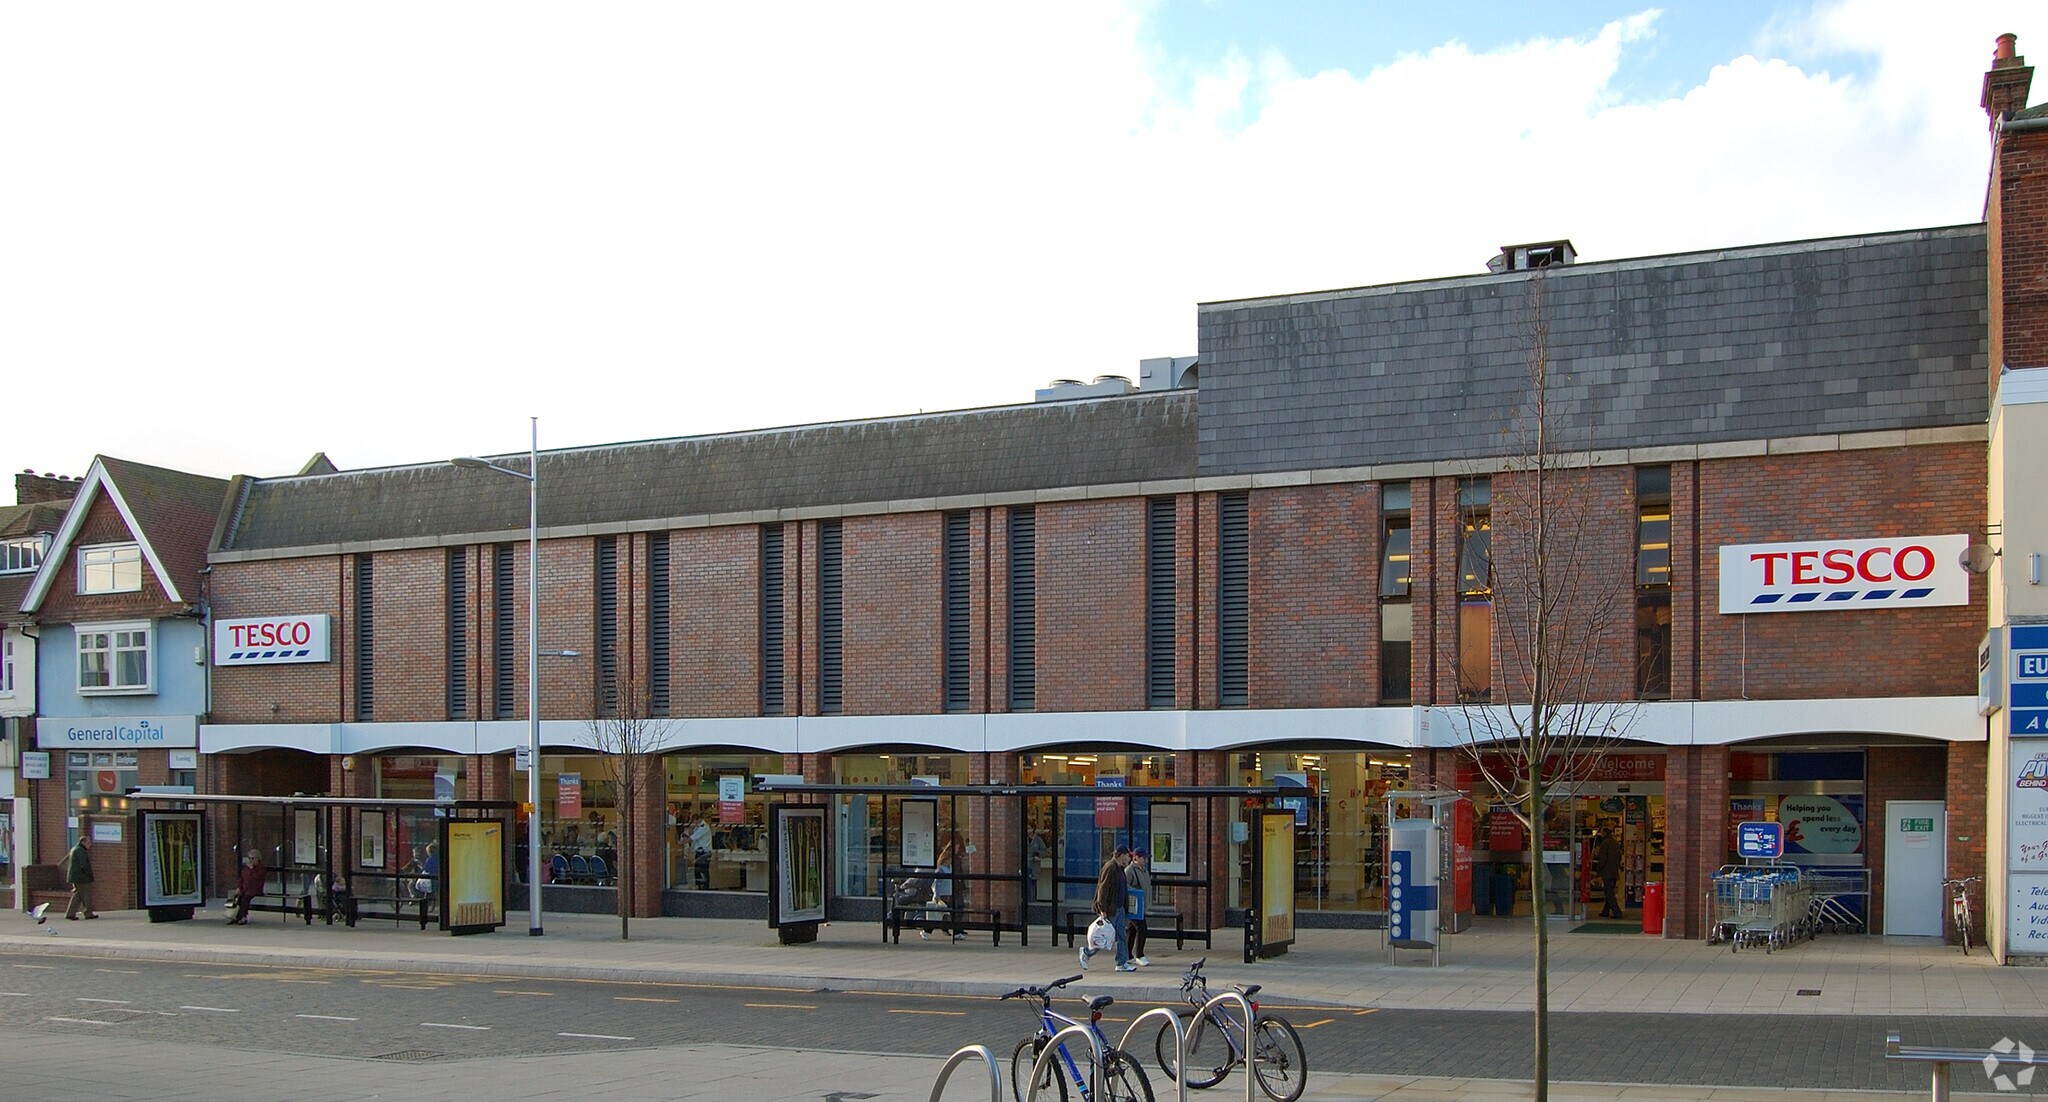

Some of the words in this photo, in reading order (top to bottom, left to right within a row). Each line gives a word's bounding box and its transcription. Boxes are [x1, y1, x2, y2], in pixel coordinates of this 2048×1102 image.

[1750, 545, 1936, 586] TESCO
[228, 621, 311, 648] TESCO
[1596, 757, 1656, 770] Welcome
[2018, 760, 2048, 779] PO
[2018, 780, 2047, 788] BEHIND
[1732, 802, 1762, 811] Thanks
[1786, 804, 1815, 813] Helping
[1819, 826, 1841, 834] every
[1842, 825, 1857, 833] day
